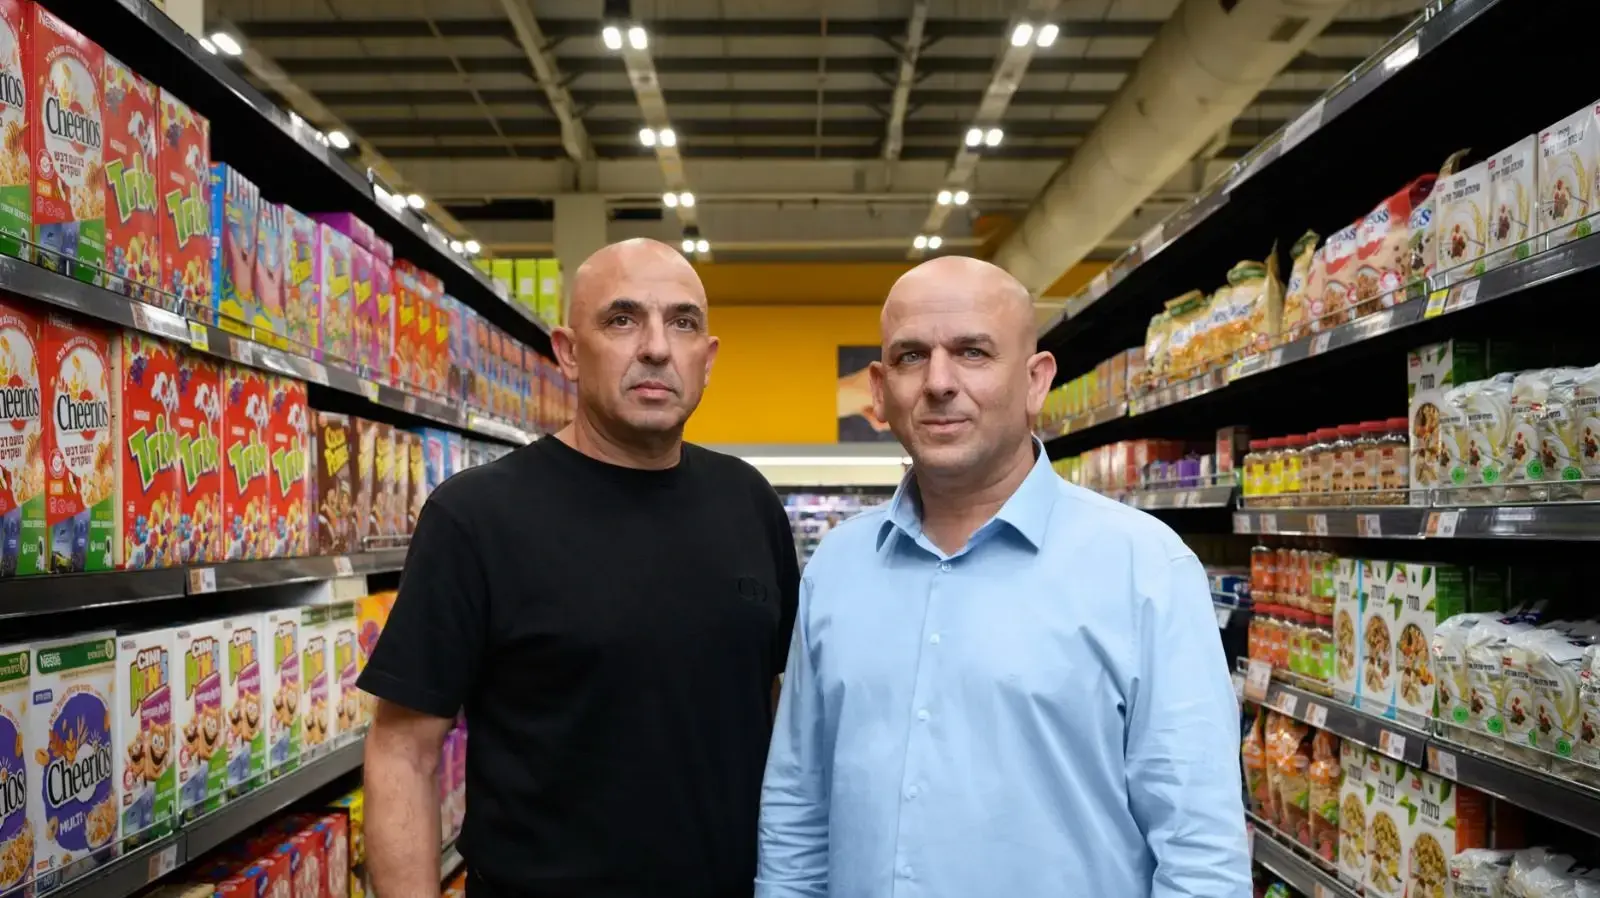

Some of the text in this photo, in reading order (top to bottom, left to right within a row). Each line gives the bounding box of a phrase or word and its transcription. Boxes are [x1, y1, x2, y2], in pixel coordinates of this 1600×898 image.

[45, 97, 102, 149] Cheerios
[54, 151, 68, 163] דבש
[105, 152, 157, 223] Trix
[165, 183, 211, 250] Trix
[57, 395, 108, 431] Cheerios
[9, 435, 25, 446] בטעם
[64, 444, 94, 457] בטעם דבש
[70, 455, 92, 467] ושקדים
[128, 413, 180, 492] Trix
[180, 421, 220, 493] Trix
[228, 429, 269, 496] Trix
[271, 436, 306, 498] Trix
[137, 648, 162, 671] CINI
[48, 744, 112, 806] Cheerios
[60, 811, 84, 836] MULTI
